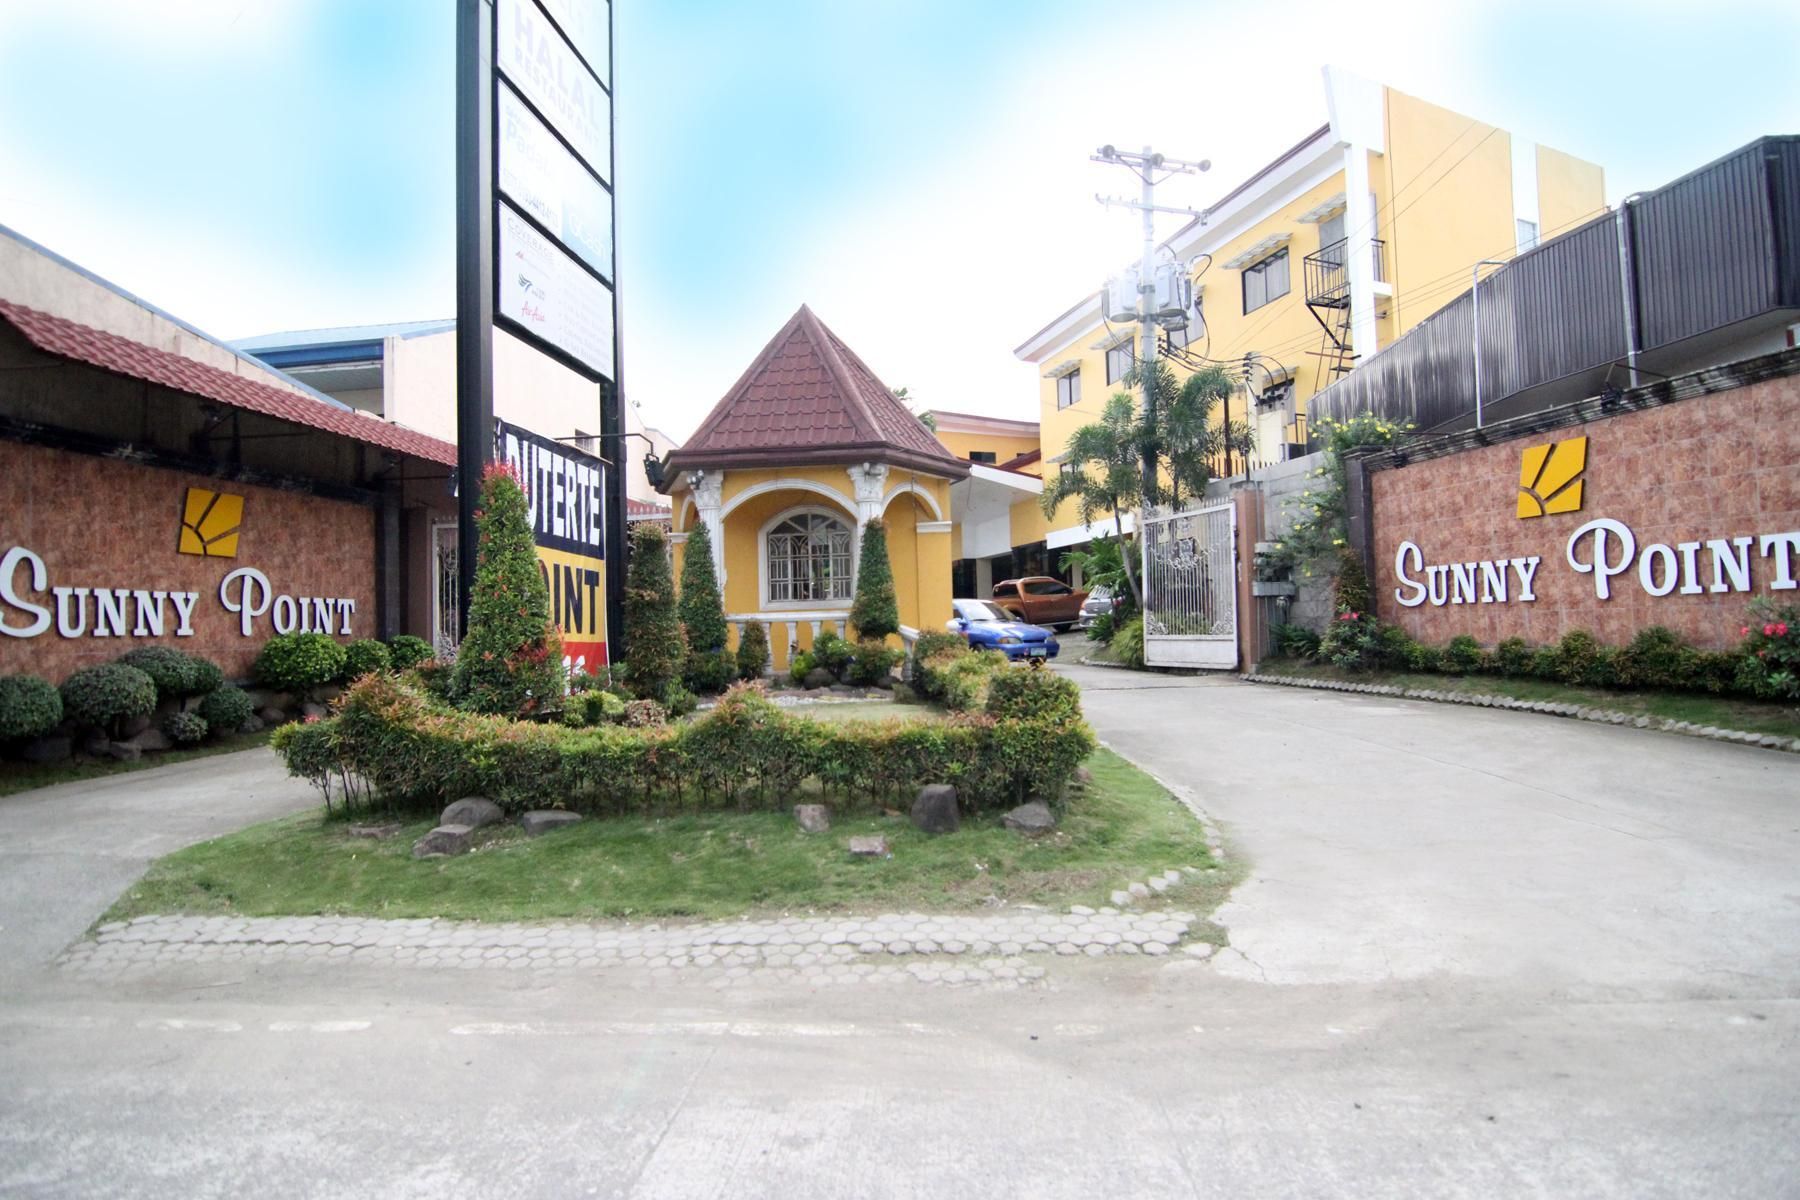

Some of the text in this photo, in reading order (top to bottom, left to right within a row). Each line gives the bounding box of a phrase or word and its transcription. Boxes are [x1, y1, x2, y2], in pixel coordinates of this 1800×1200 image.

[515, 2, 599, 131] HALAL
[515, 45, 600, 147] RESTAURANT
[220, 567, 356, 637] POINT
[1395, 518, 1800, 607] SUNNY POINT
